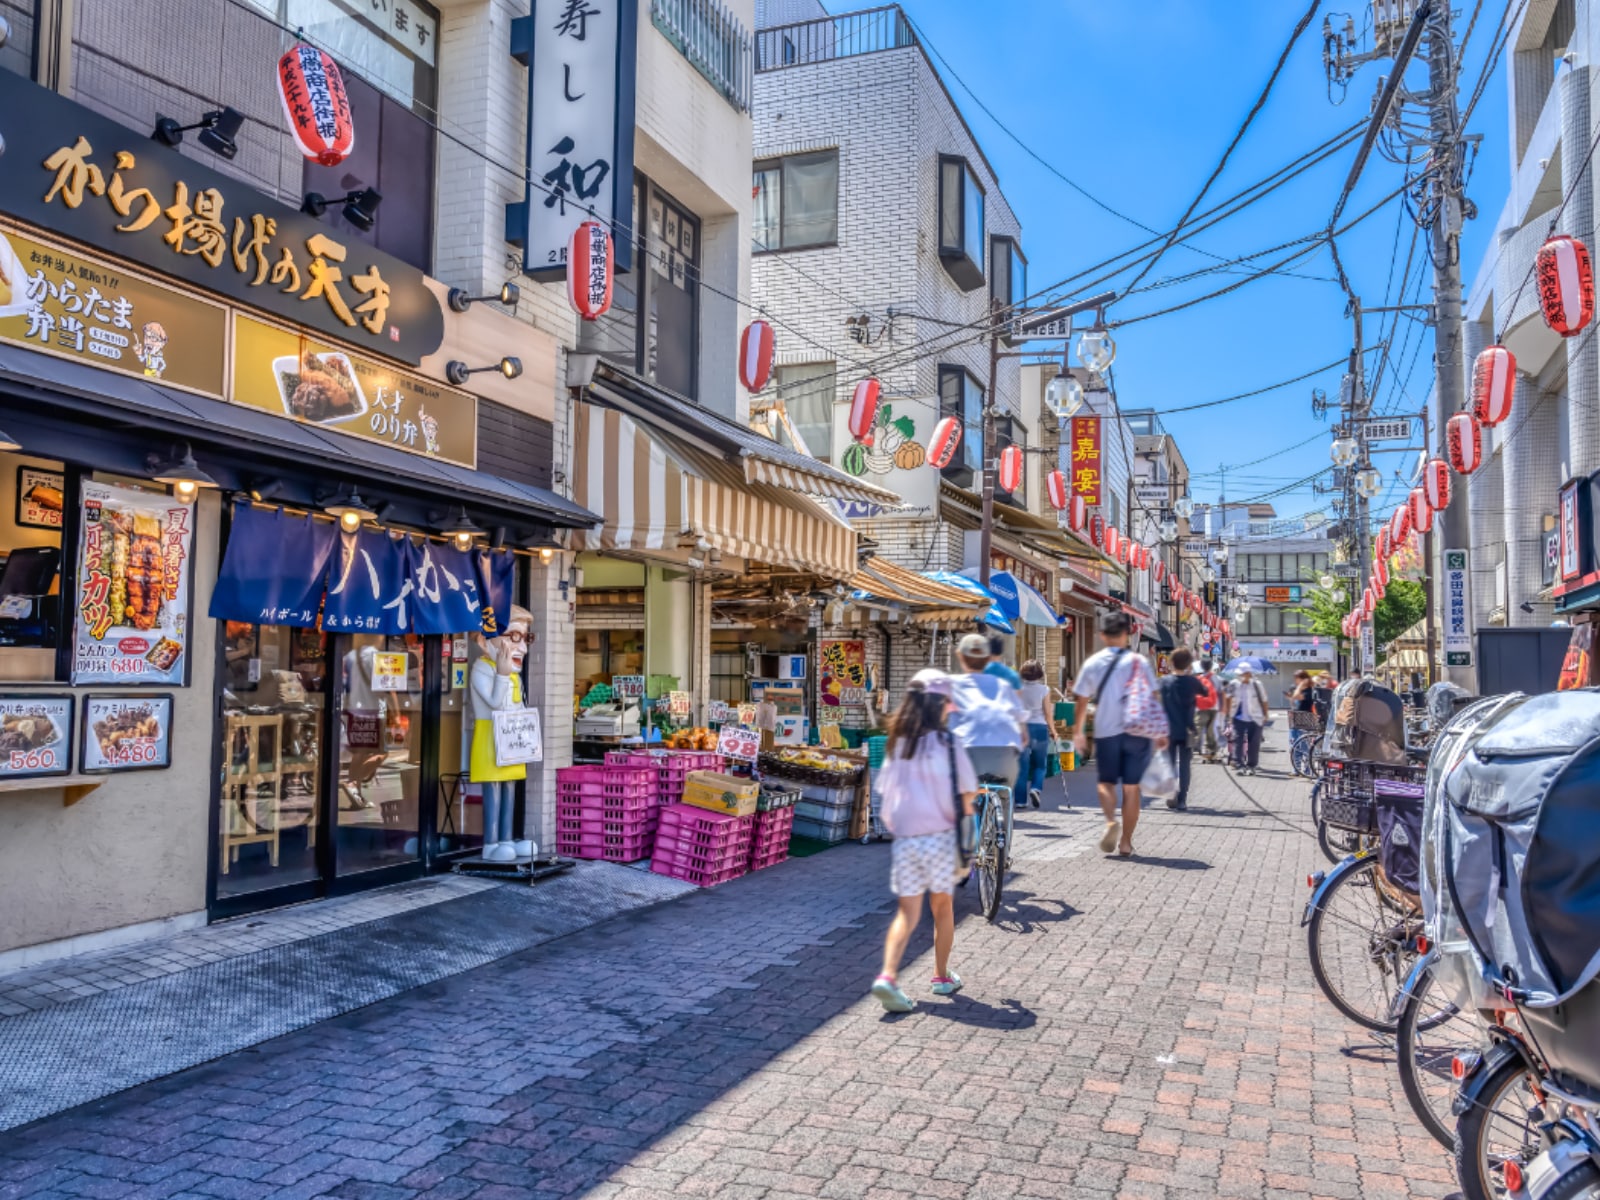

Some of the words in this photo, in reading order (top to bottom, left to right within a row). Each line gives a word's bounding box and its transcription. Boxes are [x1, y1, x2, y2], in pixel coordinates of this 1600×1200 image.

[44, 135, 391, 336] から揚げの天才
[26, 269, 133, 330] からたま
[25, 304, 85, 352] 弁当
[370, 412, 418, 446] のり弁
[166, 507, 189, 601] 夏の暑さに
[260, 606, 313, 622] ハイボール
[327, 615, 337, 627] &
[77, 643, 117, 657] とんかつ
[724, 738, 757, 756] 98
